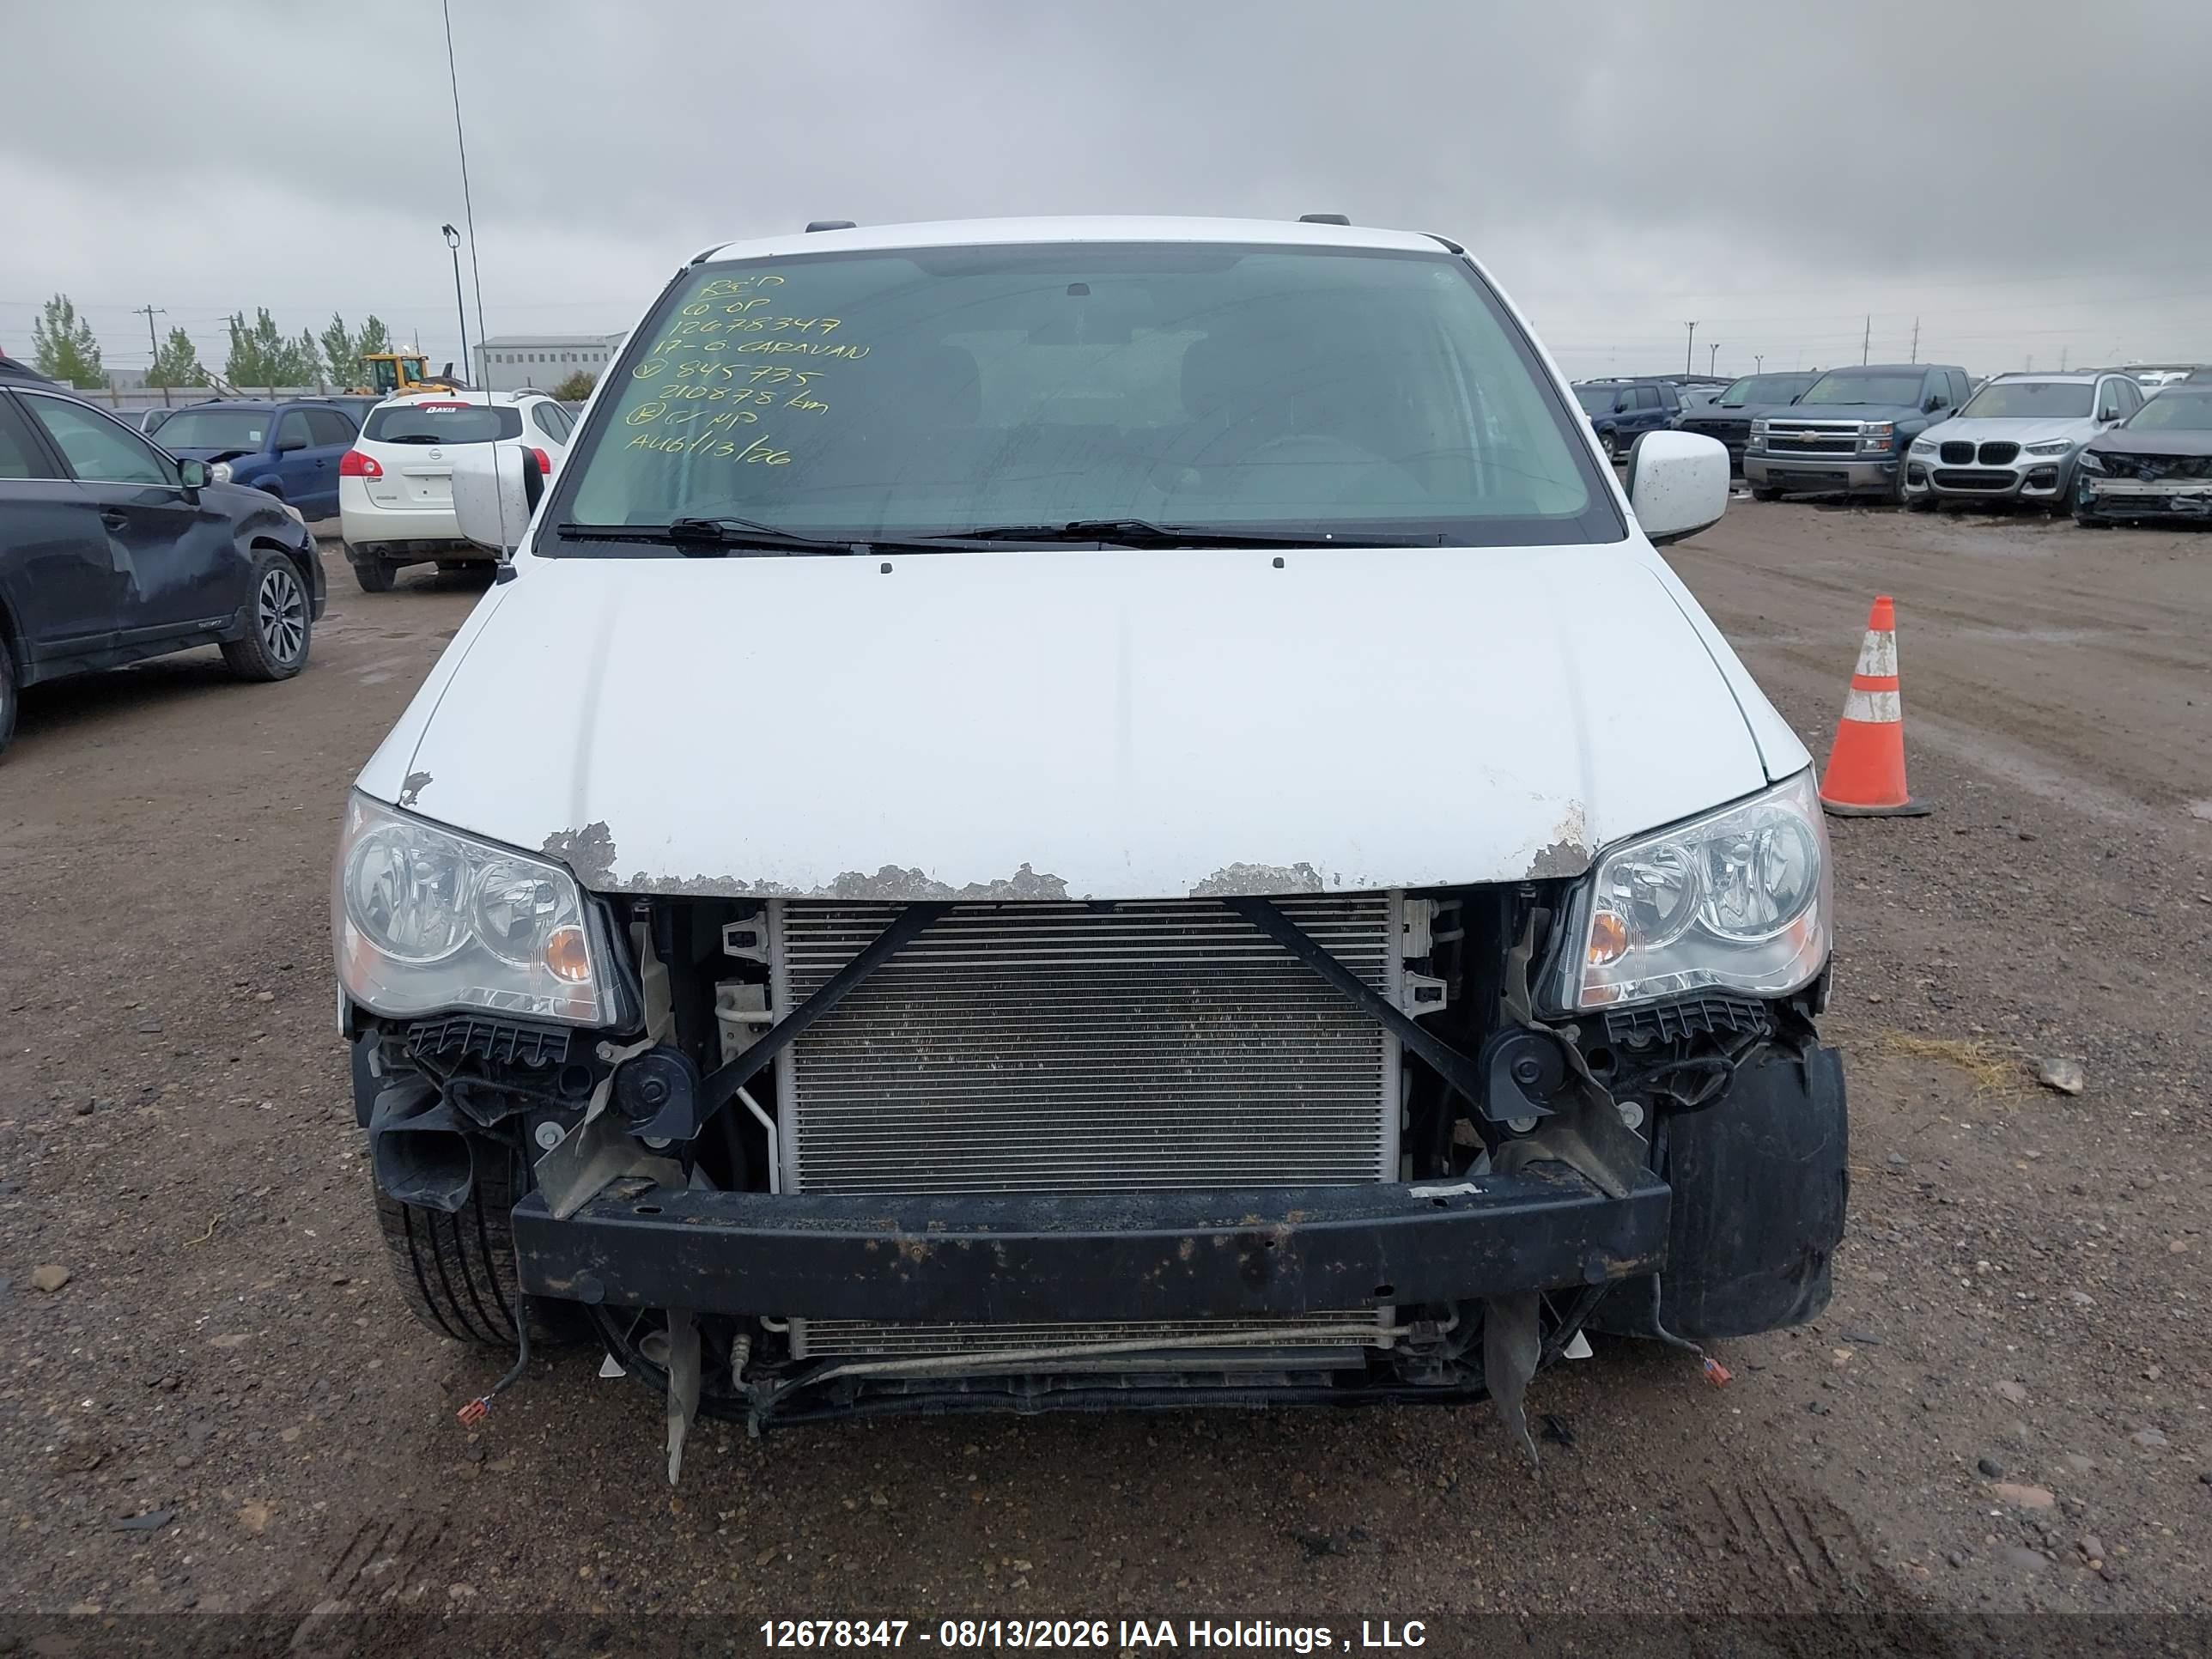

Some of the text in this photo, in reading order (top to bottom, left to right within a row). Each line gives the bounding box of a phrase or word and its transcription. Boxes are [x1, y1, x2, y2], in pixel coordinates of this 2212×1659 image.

[668, 316, 842, 337] 12678347
[737, 340, 871, 359] CARAVAN
[659, 385, 777, 404] 210878
